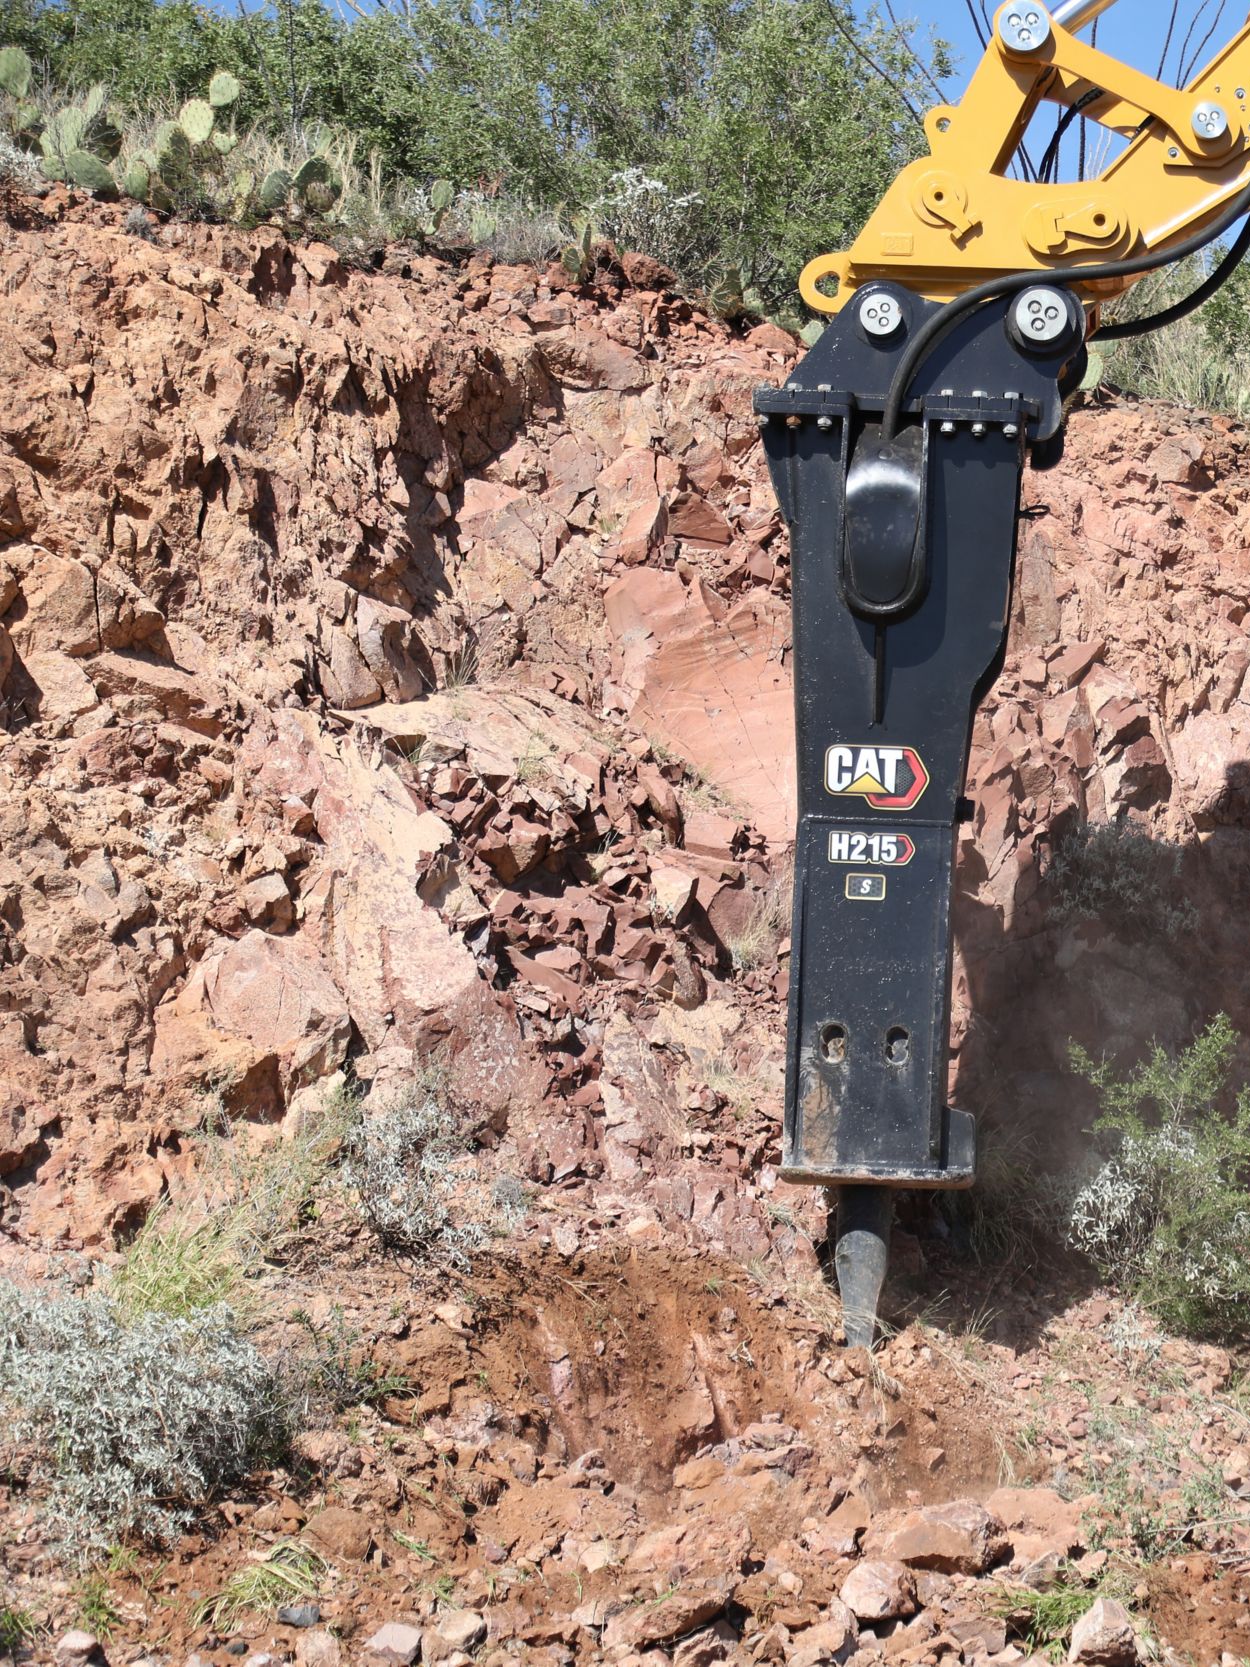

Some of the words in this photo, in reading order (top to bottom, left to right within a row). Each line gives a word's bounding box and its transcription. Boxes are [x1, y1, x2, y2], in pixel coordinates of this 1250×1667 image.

[827, 746, 903, 794] CAT
[831, 833, 898, 862] H215
[860, 879, 871, 894] S
